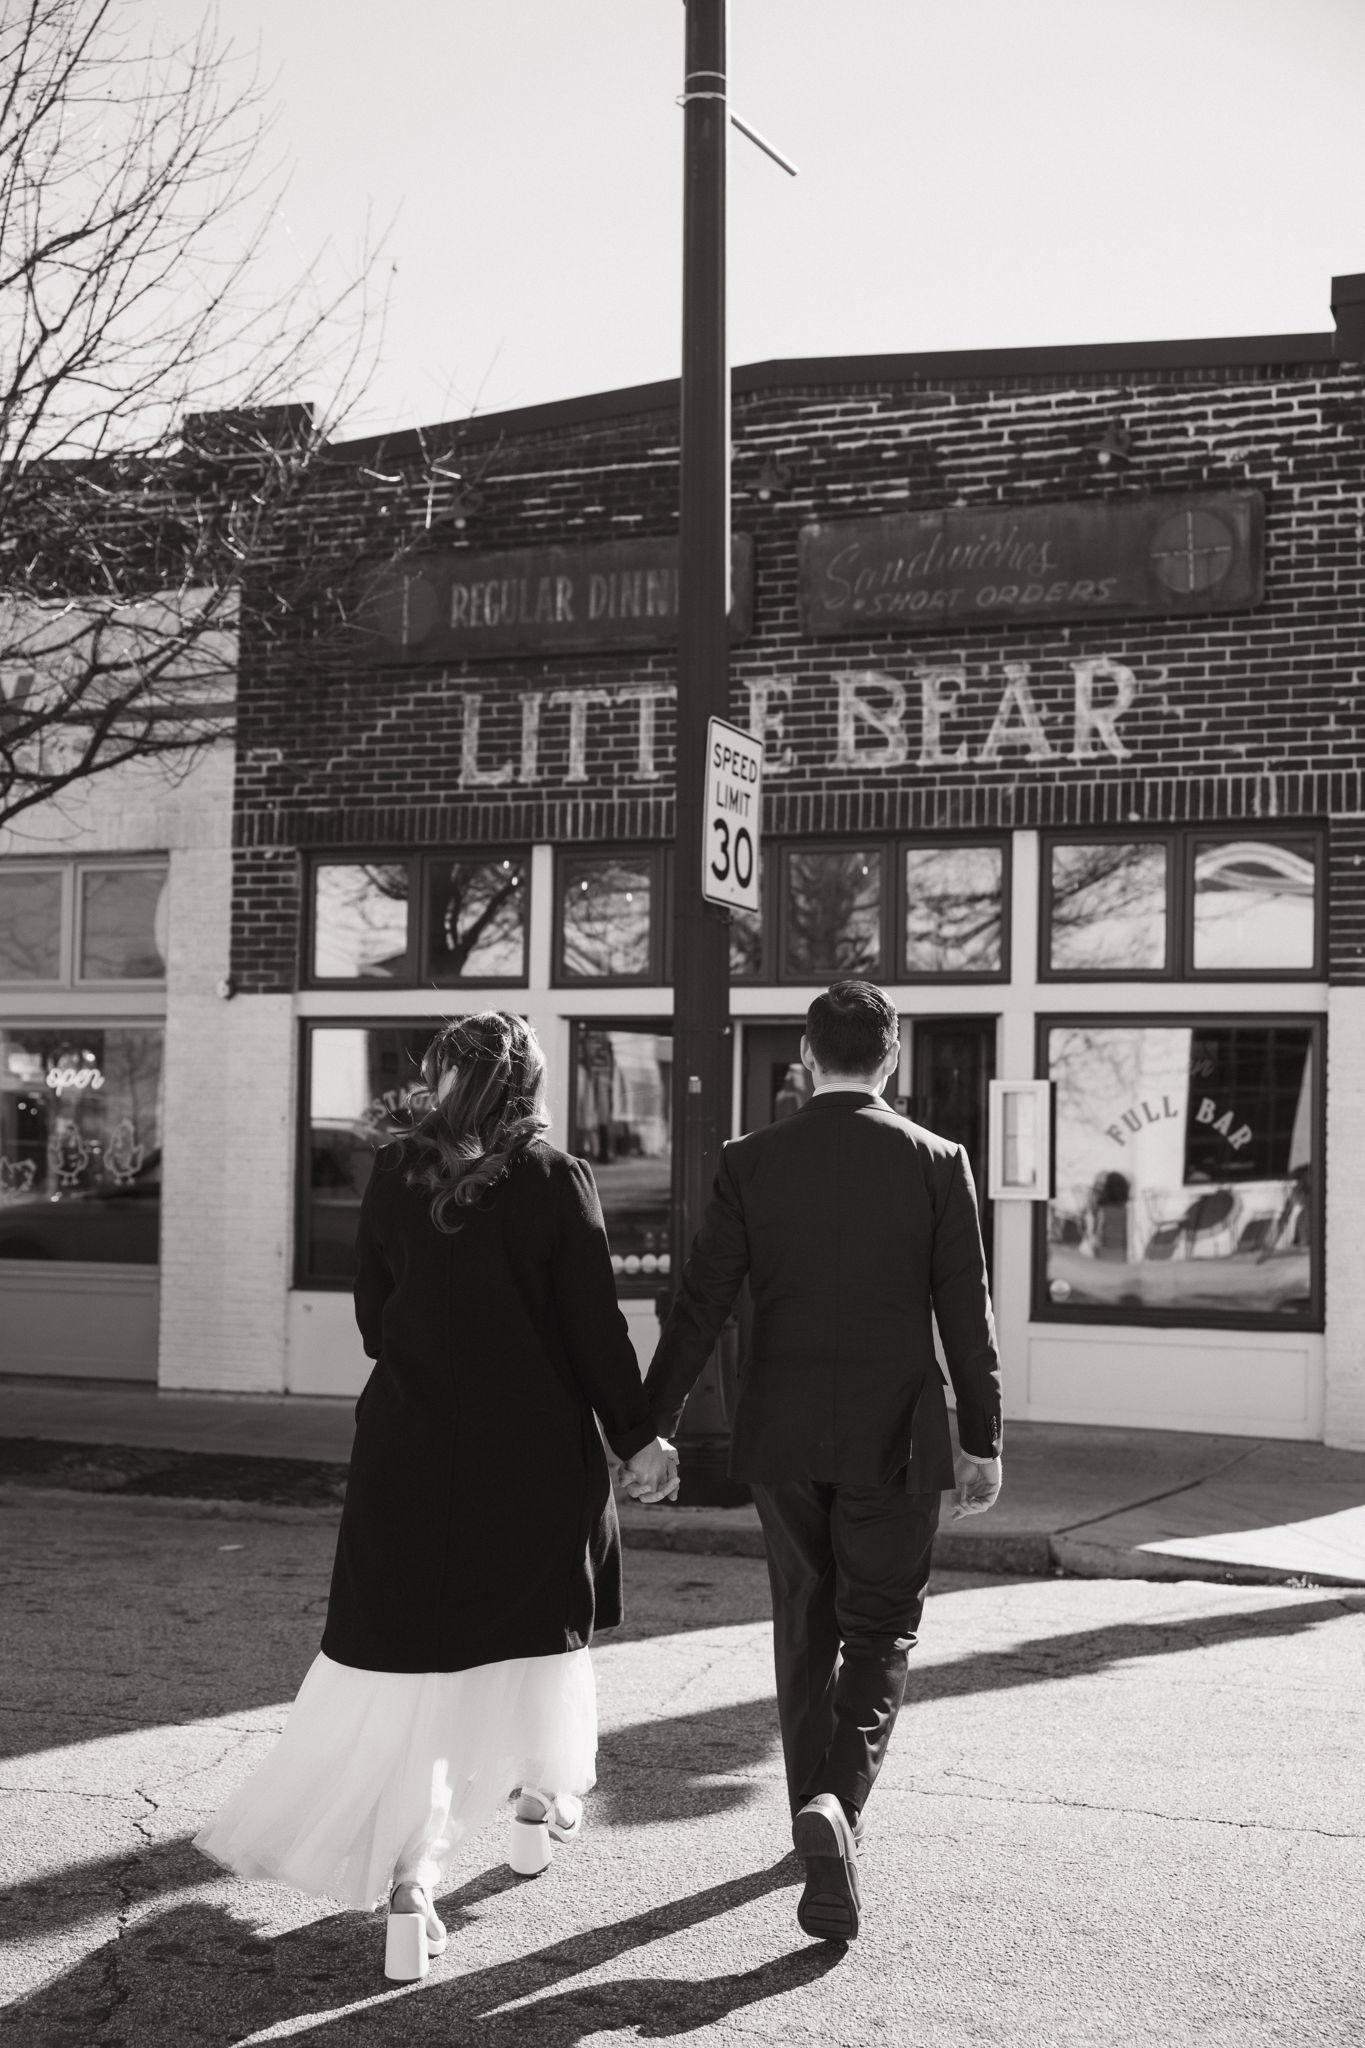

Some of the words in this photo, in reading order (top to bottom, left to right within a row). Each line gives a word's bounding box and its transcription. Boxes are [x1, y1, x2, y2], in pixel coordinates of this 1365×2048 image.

[824, 525, 1057, 610] Sandwiches
[451, 575, 574, 628] REGULAR
[588, 568, 679, 621] DINN
[865, 587, 966, 616] SHORT
[976, 577, 1118, 608] ORDERS
[457, 674, 797, 786] LITTE
[828, 657, 1137, 769] BEAR
[713, 742, 758, 783] SPEED
[716, 780, 751, 818] LIMIT
[711, 818, 753, 889] 30
[1105, 1096, 1179, 1147] FULL
[1195, 1097, 1253, 1151] BAR
